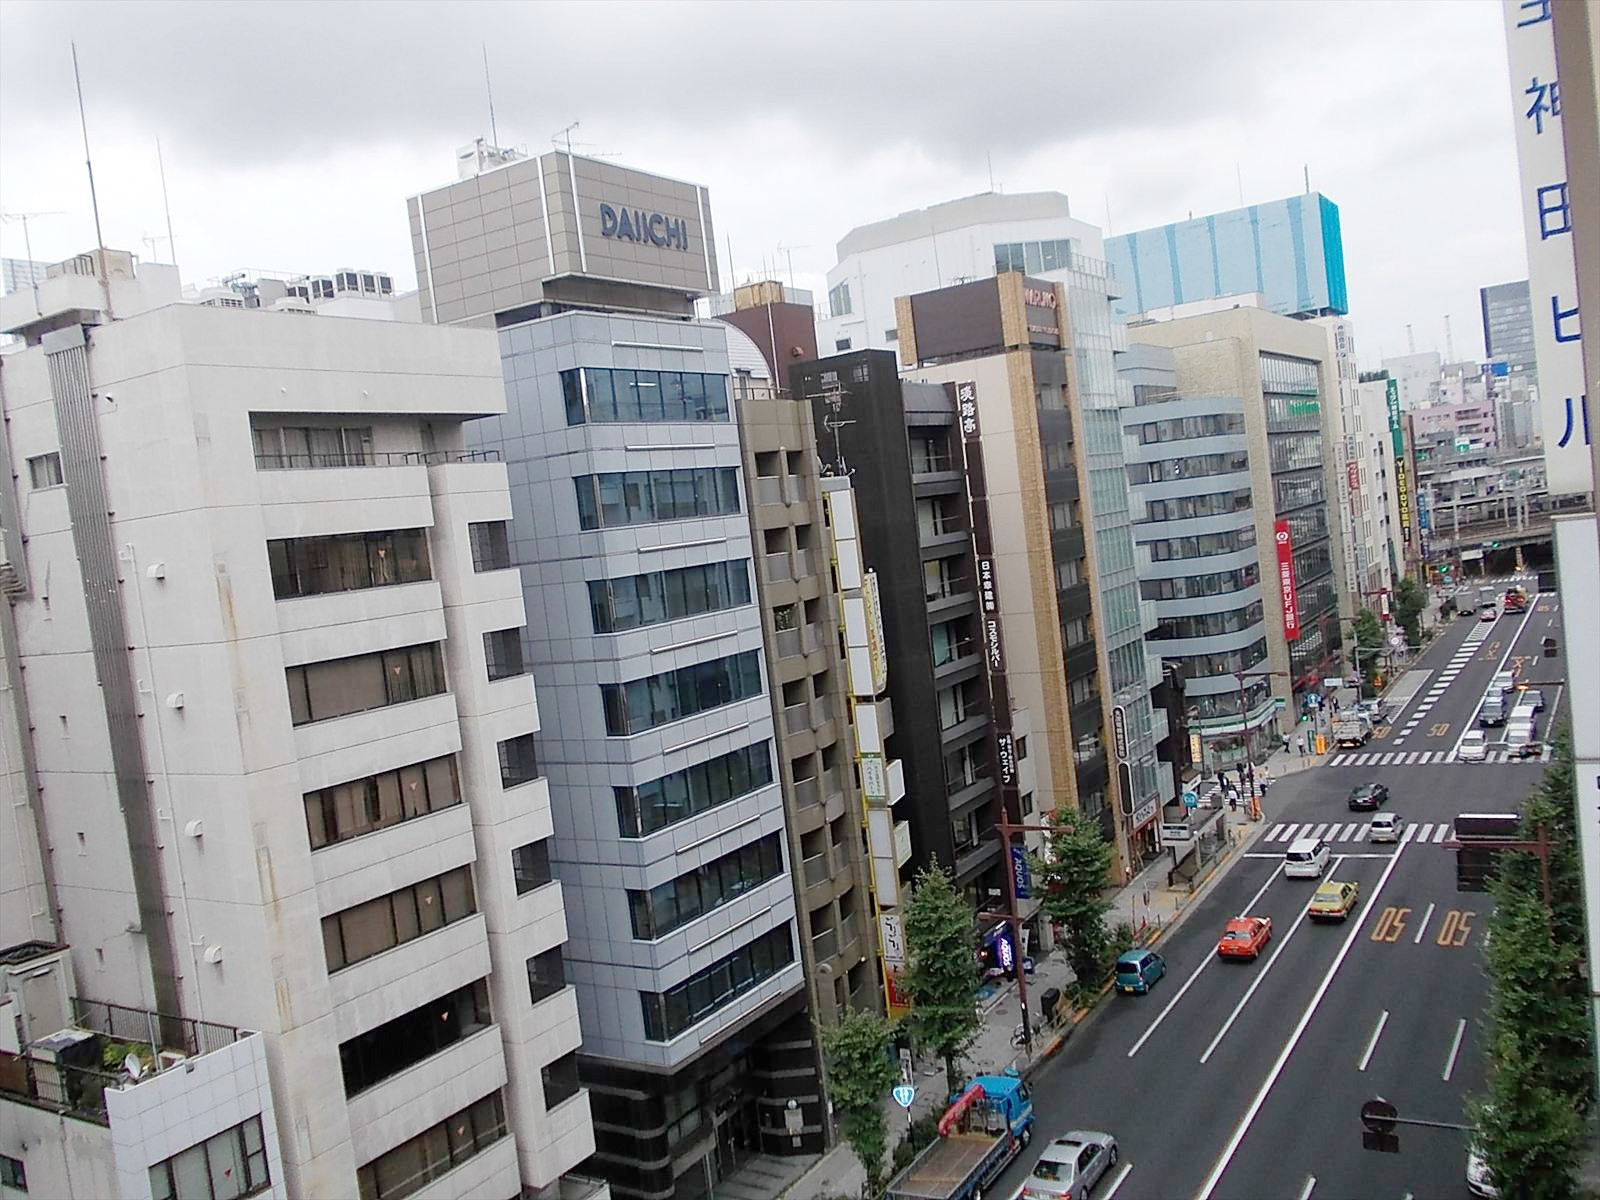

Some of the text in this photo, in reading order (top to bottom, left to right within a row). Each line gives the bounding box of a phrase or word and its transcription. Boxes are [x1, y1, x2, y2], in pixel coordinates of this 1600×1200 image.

[600, 202, 688, 250] DAIICHI
[1014, 856, 1026, 890] AQUOS
[1001, 937, 1011, 967] AQUOS
